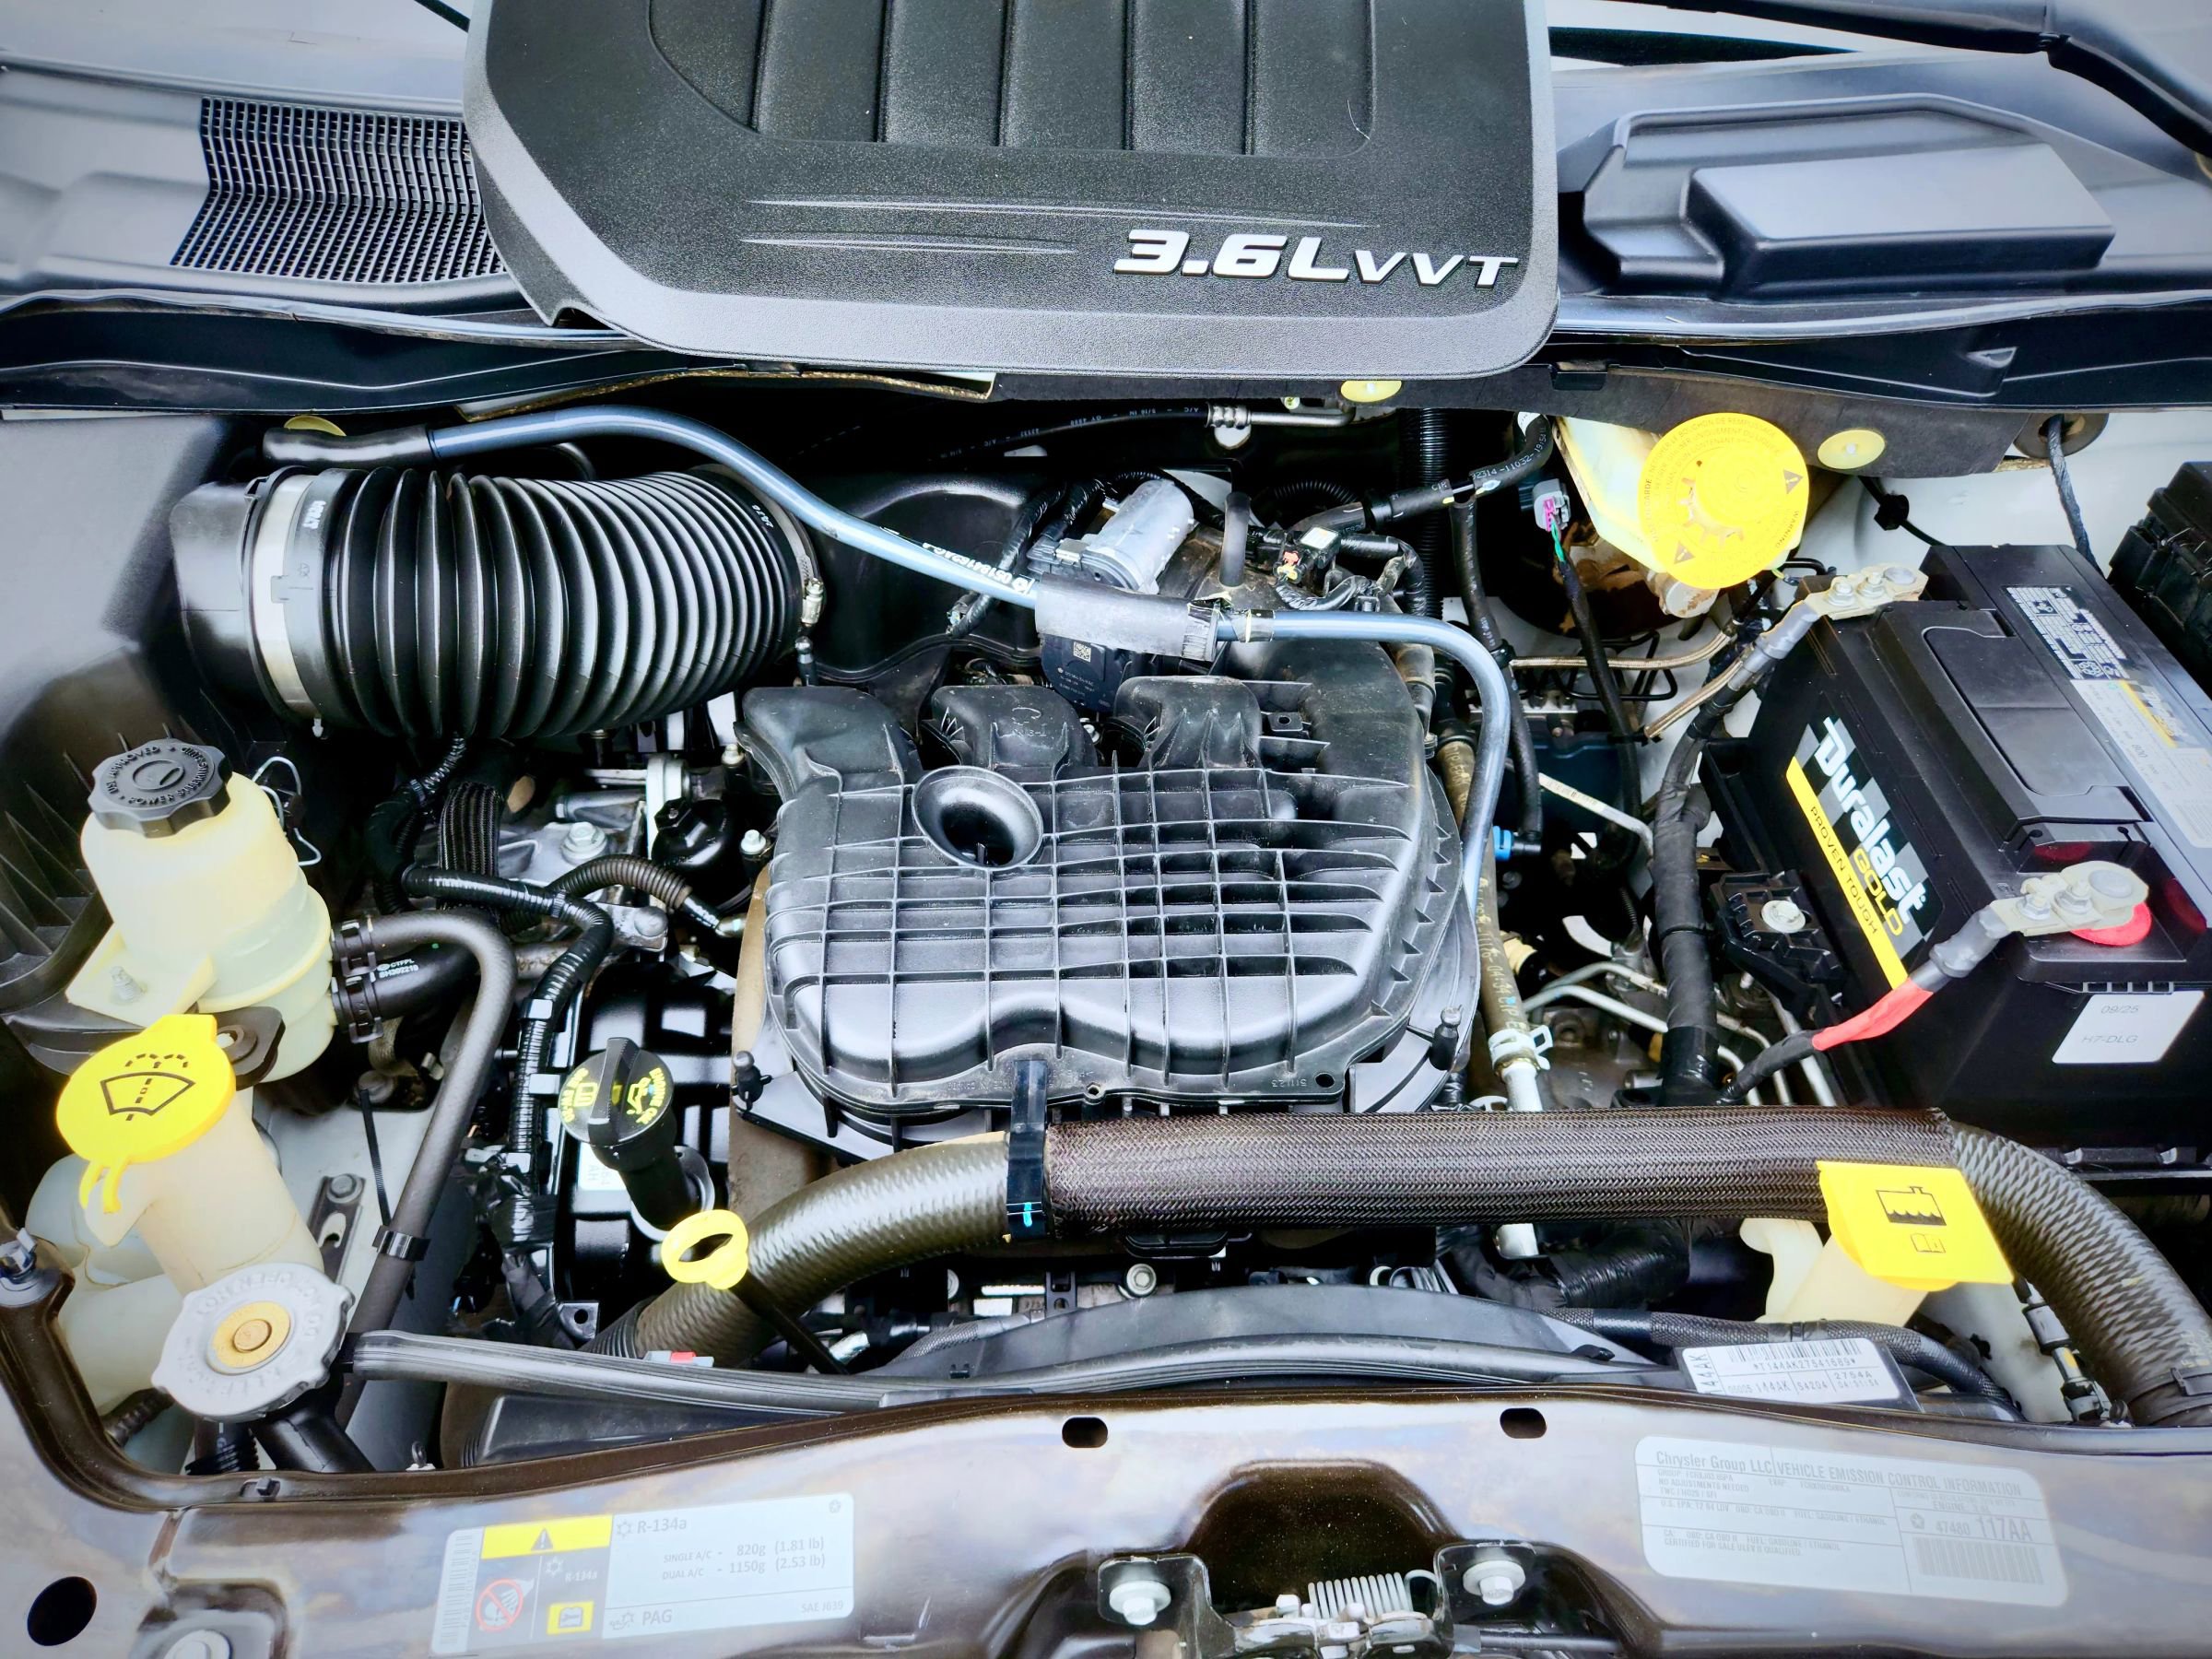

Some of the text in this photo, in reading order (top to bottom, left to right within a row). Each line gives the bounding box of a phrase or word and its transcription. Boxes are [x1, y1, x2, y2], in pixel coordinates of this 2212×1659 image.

[1813, 716, 1930, 924] Duralast
[1809, 806, 1879, 935] PROVEN TOUGH
[1849, 847, 1904, 937] GOLD
[2100, 1003, 2140, 1015] 09/25
[2080, 1032, 2139, 1046] H7-DLG
[1656, 1451, 1772, 1474] Chrysler Group LLC
[1777, 1462, 2022, 1496] VEHICLE EMISSION CONTROL INFORMATION
[636, 1516, 688, 1535] R-134a
[663, 1551, 693, 1564] SINGLE
[695, 1549, 712, 1561] A/C
[735, 1542, 767, 1559] 820g
[662, 1569, 686, 1581] DUAL
[687, 1567, 705, 1579] A/C
[728, 1559, 767, 1576] 1150g
[641, 1607, 674, 1627] PAG
[800, 1600, 820, 1614] SAE
